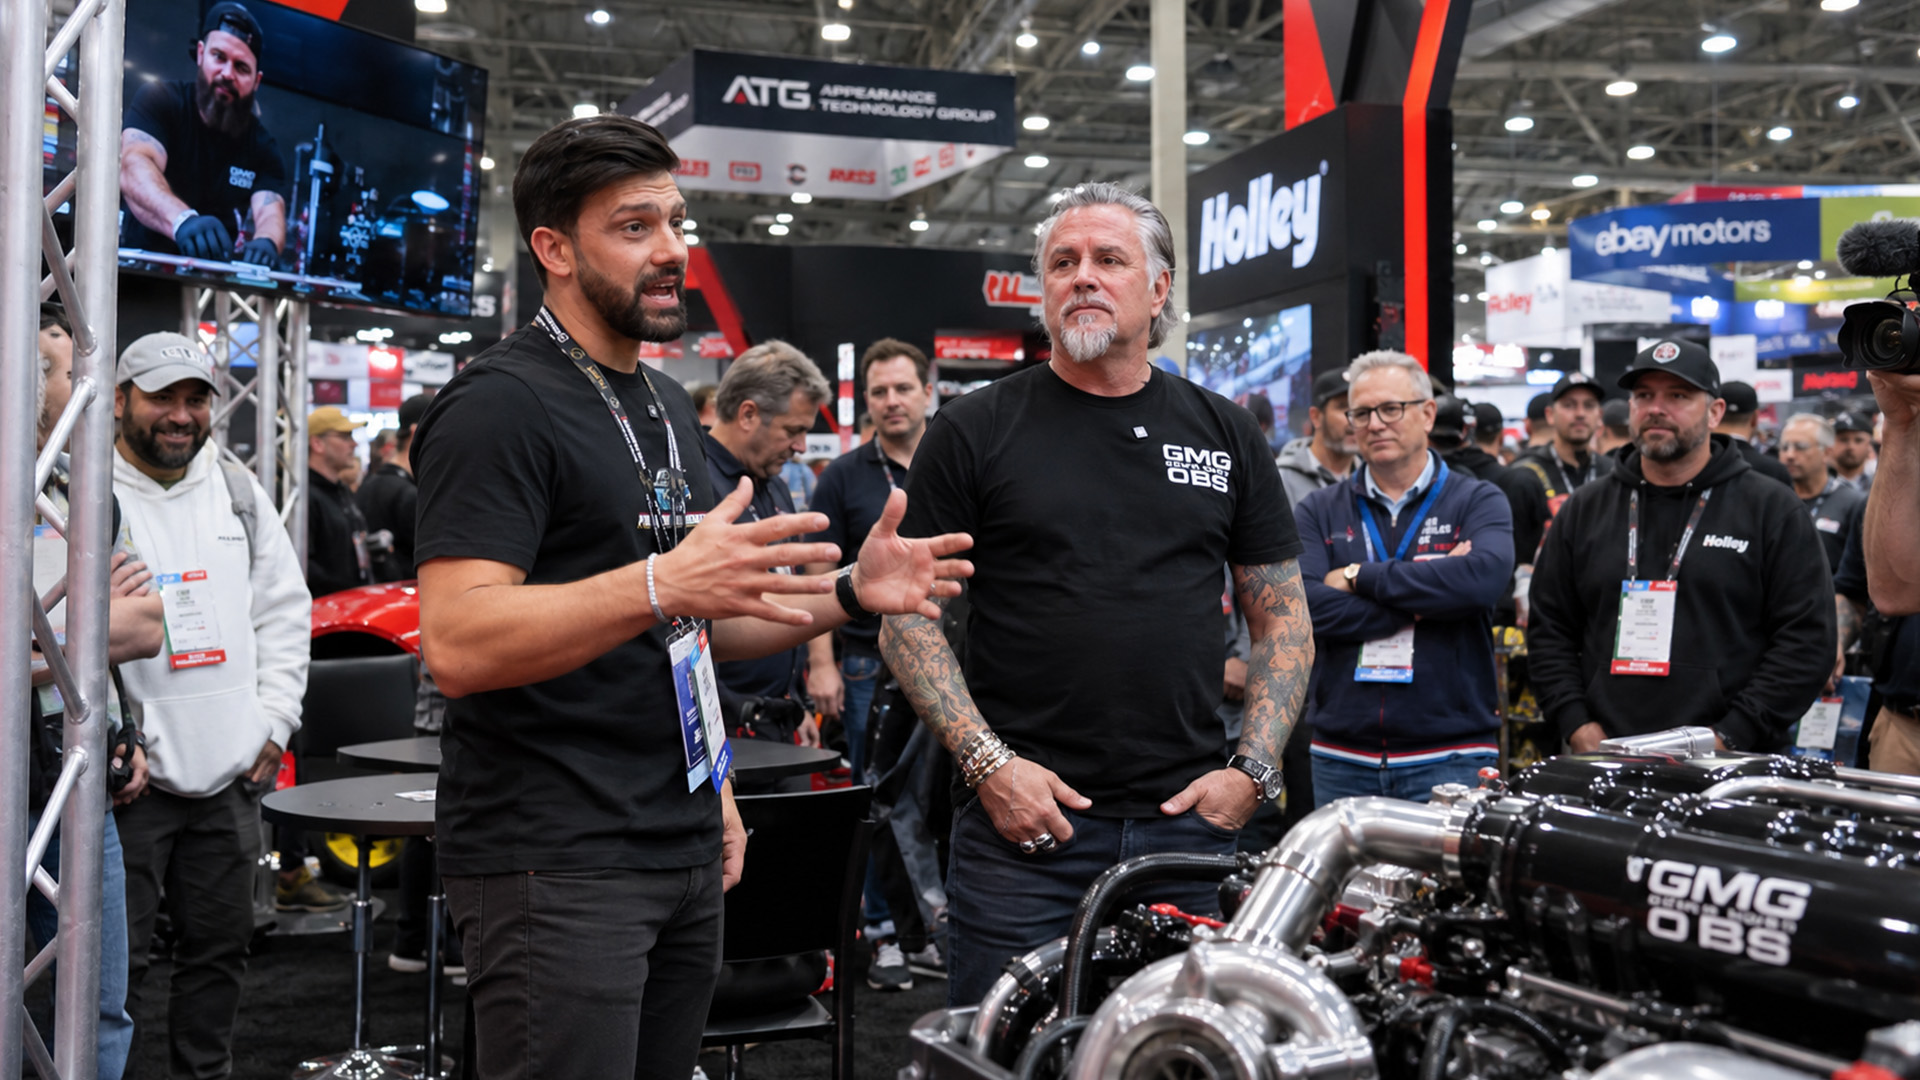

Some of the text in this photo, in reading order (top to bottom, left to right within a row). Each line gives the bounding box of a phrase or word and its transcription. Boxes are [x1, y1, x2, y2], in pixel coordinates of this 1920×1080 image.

[722, 75, 811, 110] ATG
[819, 84, 937, 105] APPEARANCE
[819, 99, 997, 123] TECHNOLOGY GROUP
[1198, 171, 1322, 275] Holley
[1595, 217, 1772, 258] ebay motors
[1162, 443, 1232, 471] GMG
[1167, 467, 1229, 493] OBS
[1702, 534, 1749, 553] Holley
[1647, 859, 1812, 921] GMG
[1646, 906, 1792, 967] OBS
